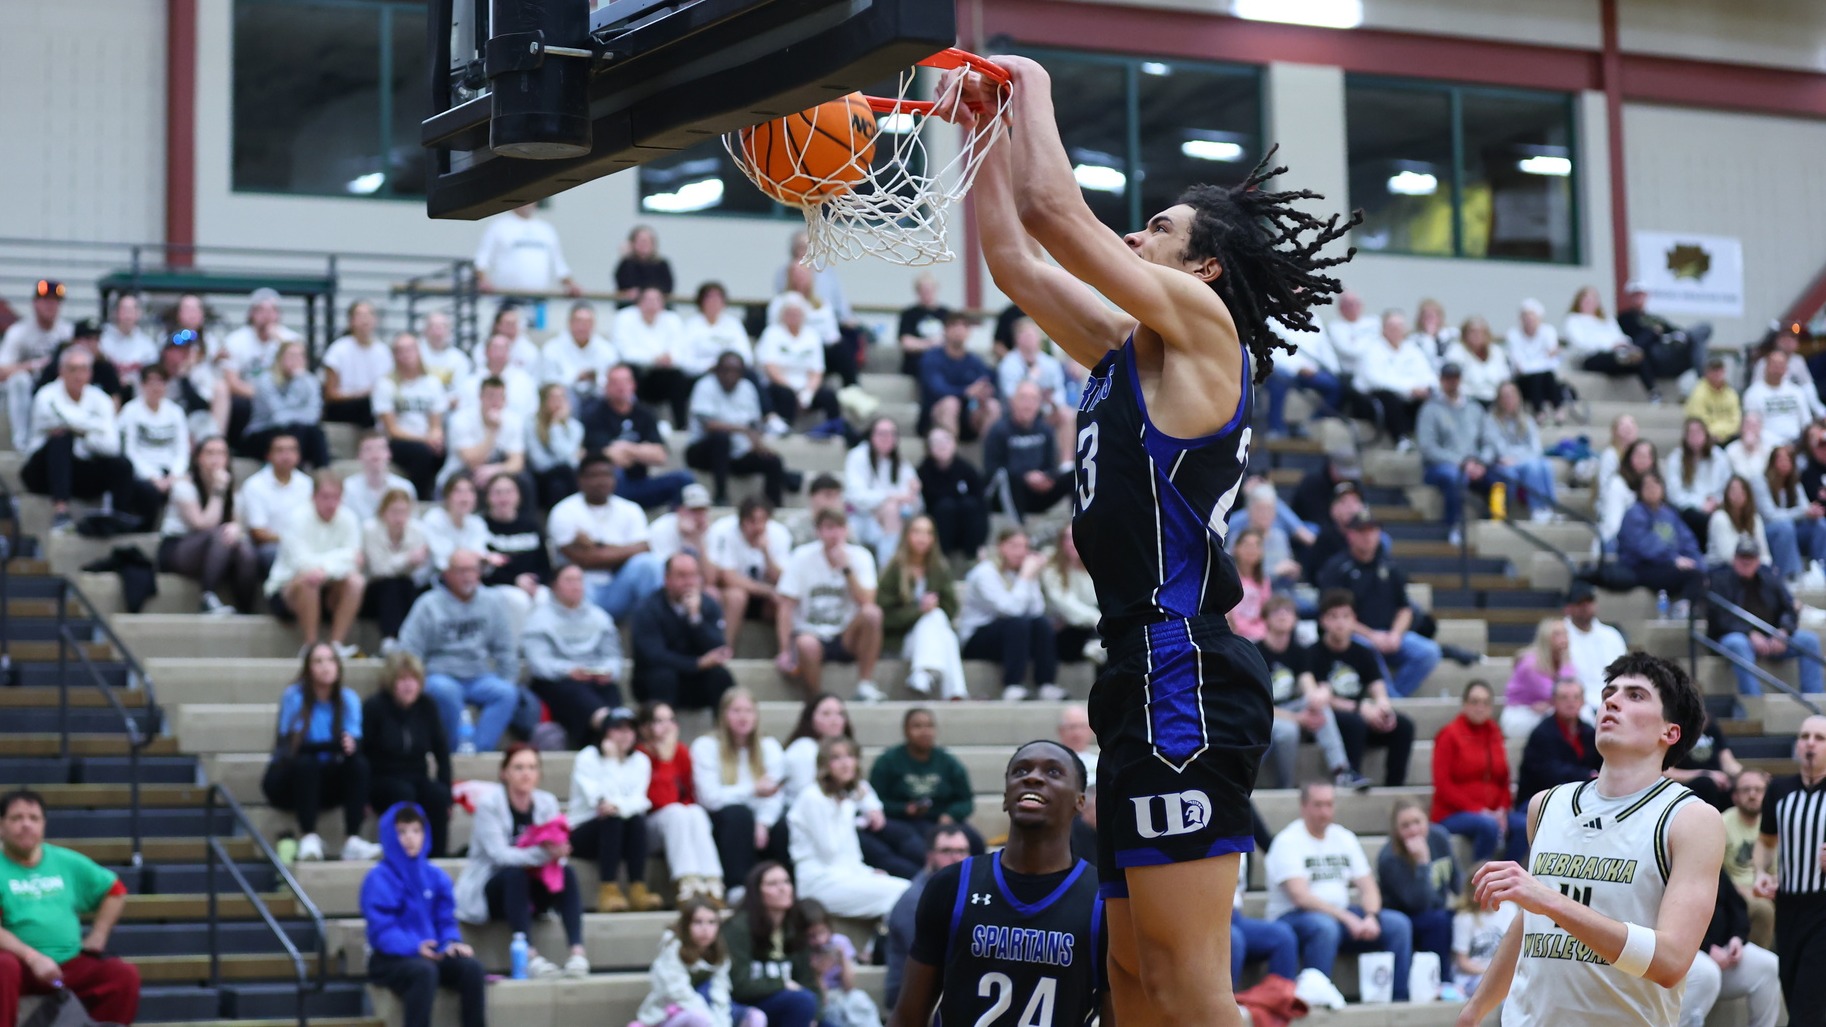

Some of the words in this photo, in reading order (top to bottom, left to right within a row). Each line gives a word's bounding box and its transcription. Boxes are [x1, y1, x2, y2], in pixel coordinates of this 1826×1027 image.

[1532, 852, 1638, 885] NEBRASKA
[971, 924, 1075, 967] SPARTANS
[1523, 932, 1610, 966] WESLEYA
[974, 971, 1058, 1027] 24
